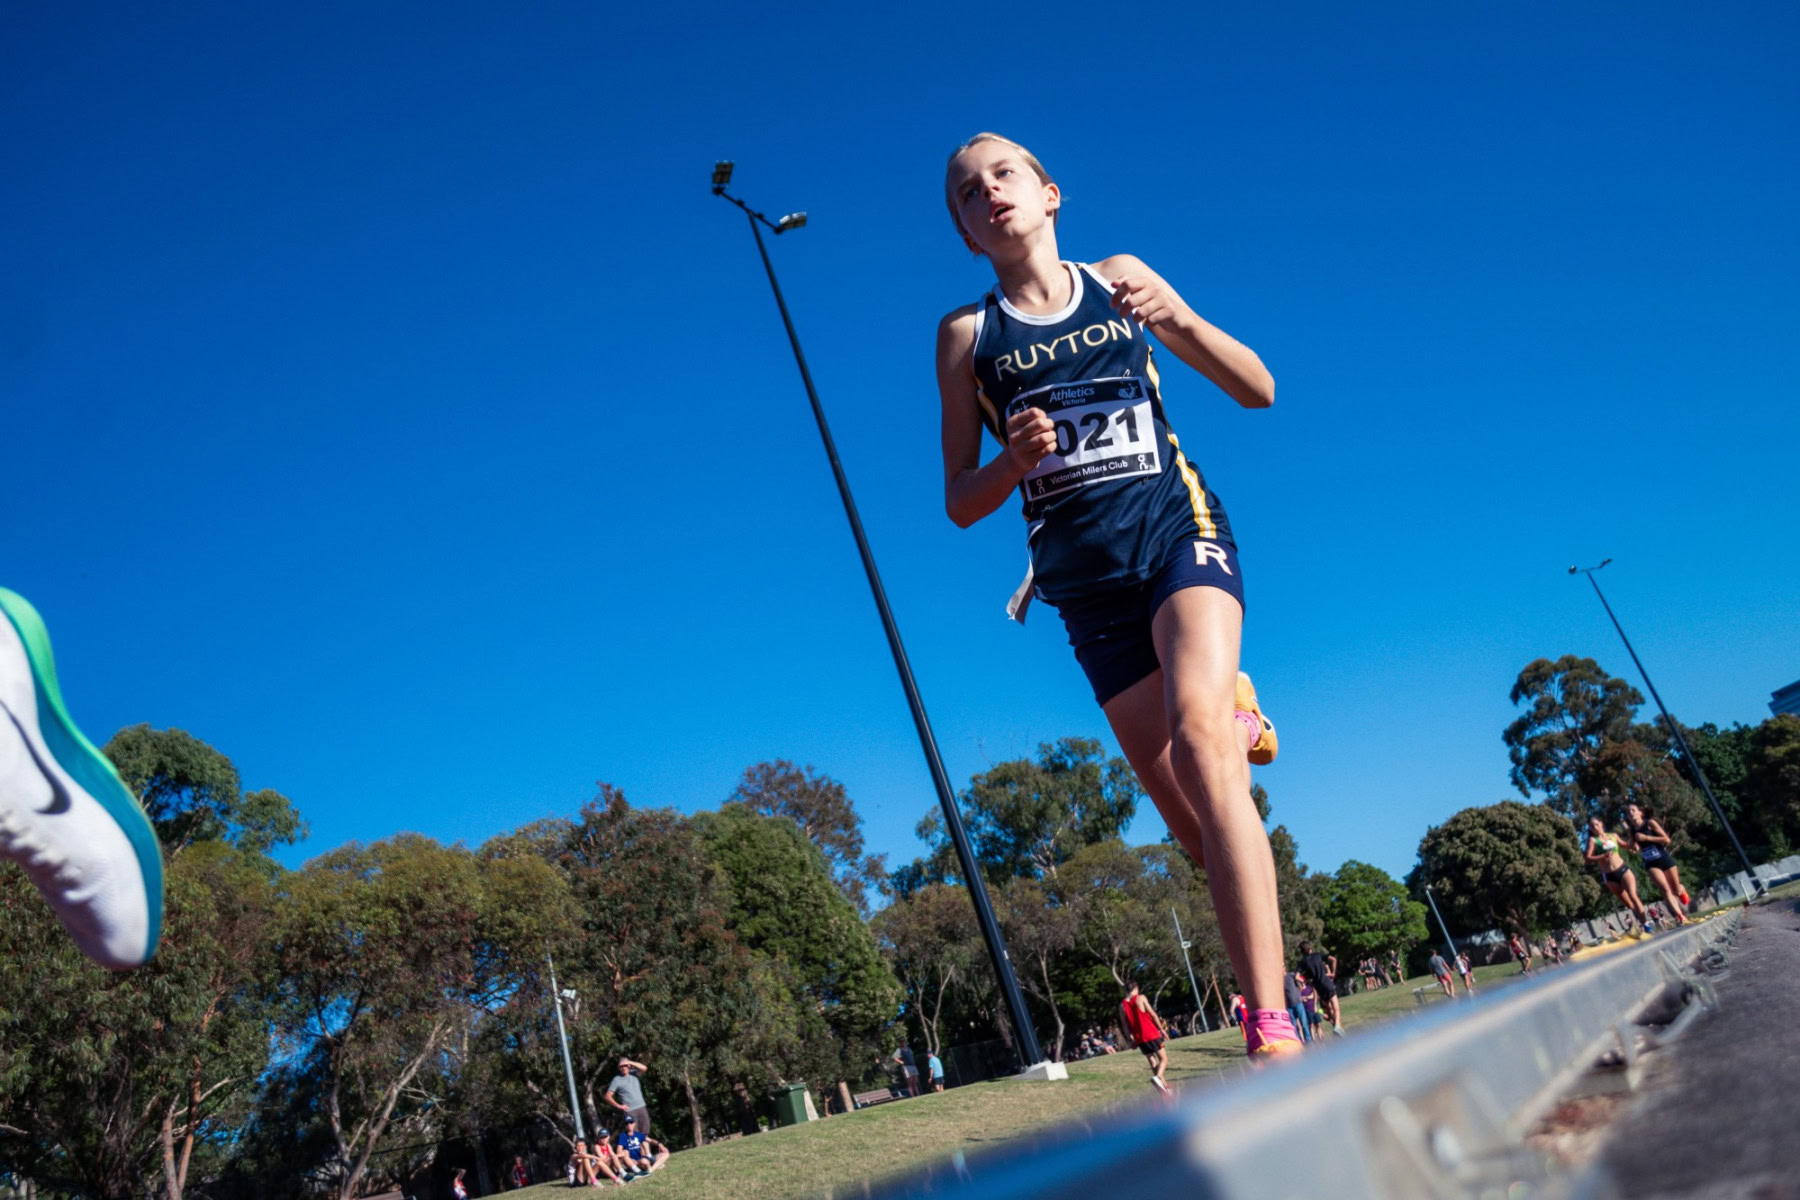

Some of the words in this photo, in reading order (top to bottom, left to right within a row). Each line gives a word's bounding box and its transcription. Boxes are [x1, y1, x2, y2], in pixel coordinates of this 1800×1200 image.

[994, 318, 1133, 382] RUYTON
[1049, 386, 1095, 403] Athletics
[1061, 398, 1086, 407] Victoria
[1049, 471, 1081, 485] Victorian
[1081, 464, 1108, 476] Milers
[1108, 459, 1129, 471] Club
[1193, 541, 1234, 576] R
